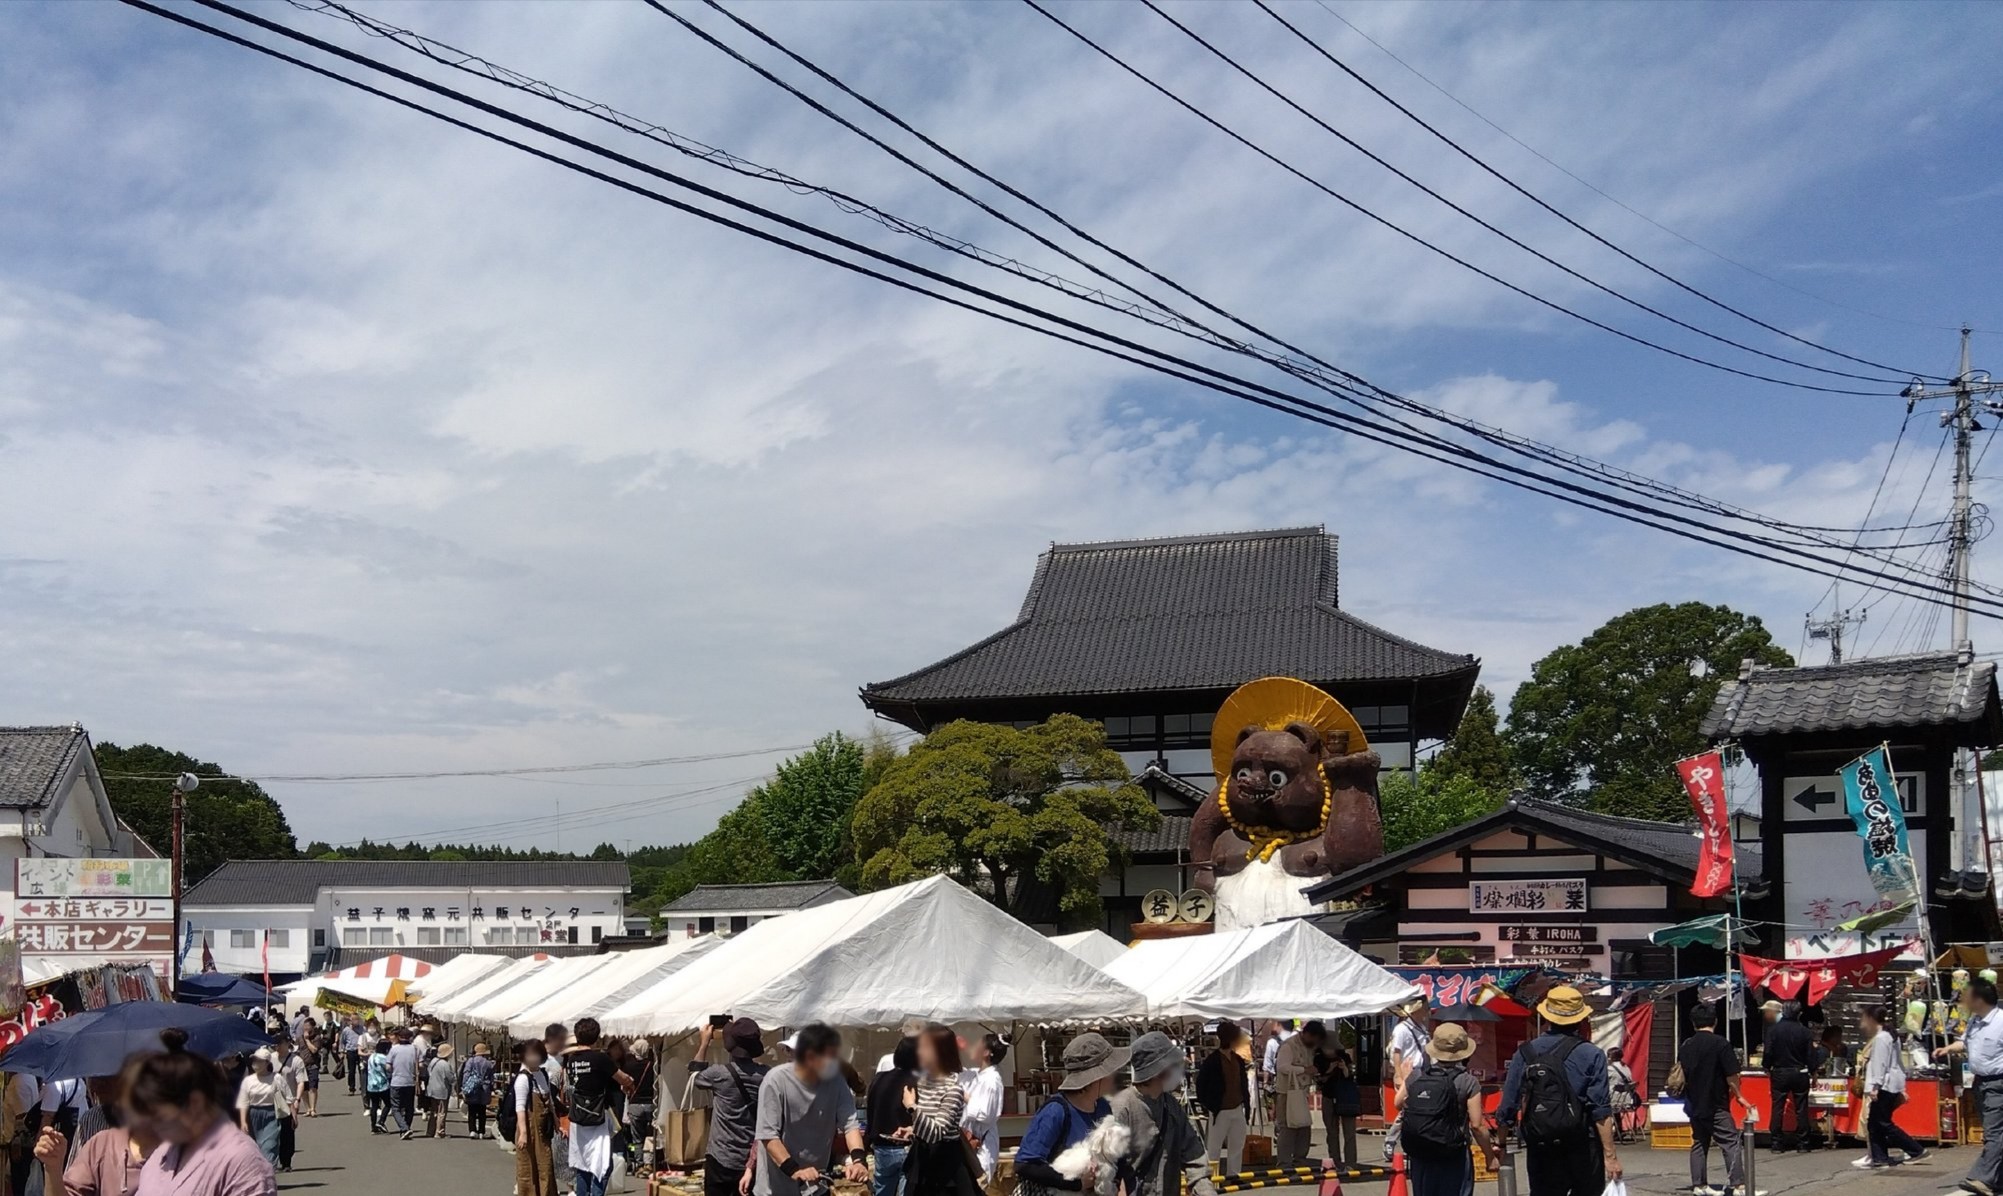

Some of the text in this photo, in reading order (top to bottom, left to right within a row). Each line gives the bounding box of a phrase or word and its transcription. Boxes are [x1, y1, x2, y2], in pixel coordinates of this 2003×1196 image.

[44, 901, 166, 917] 本店ギャラリー
[1150, 895, 1206, 918] 益子
[18, 924, 171, 950] 共販センター
[1546, 928, 1581, 940] IROHA
[1393, 973, 1496, 1007] きそば
